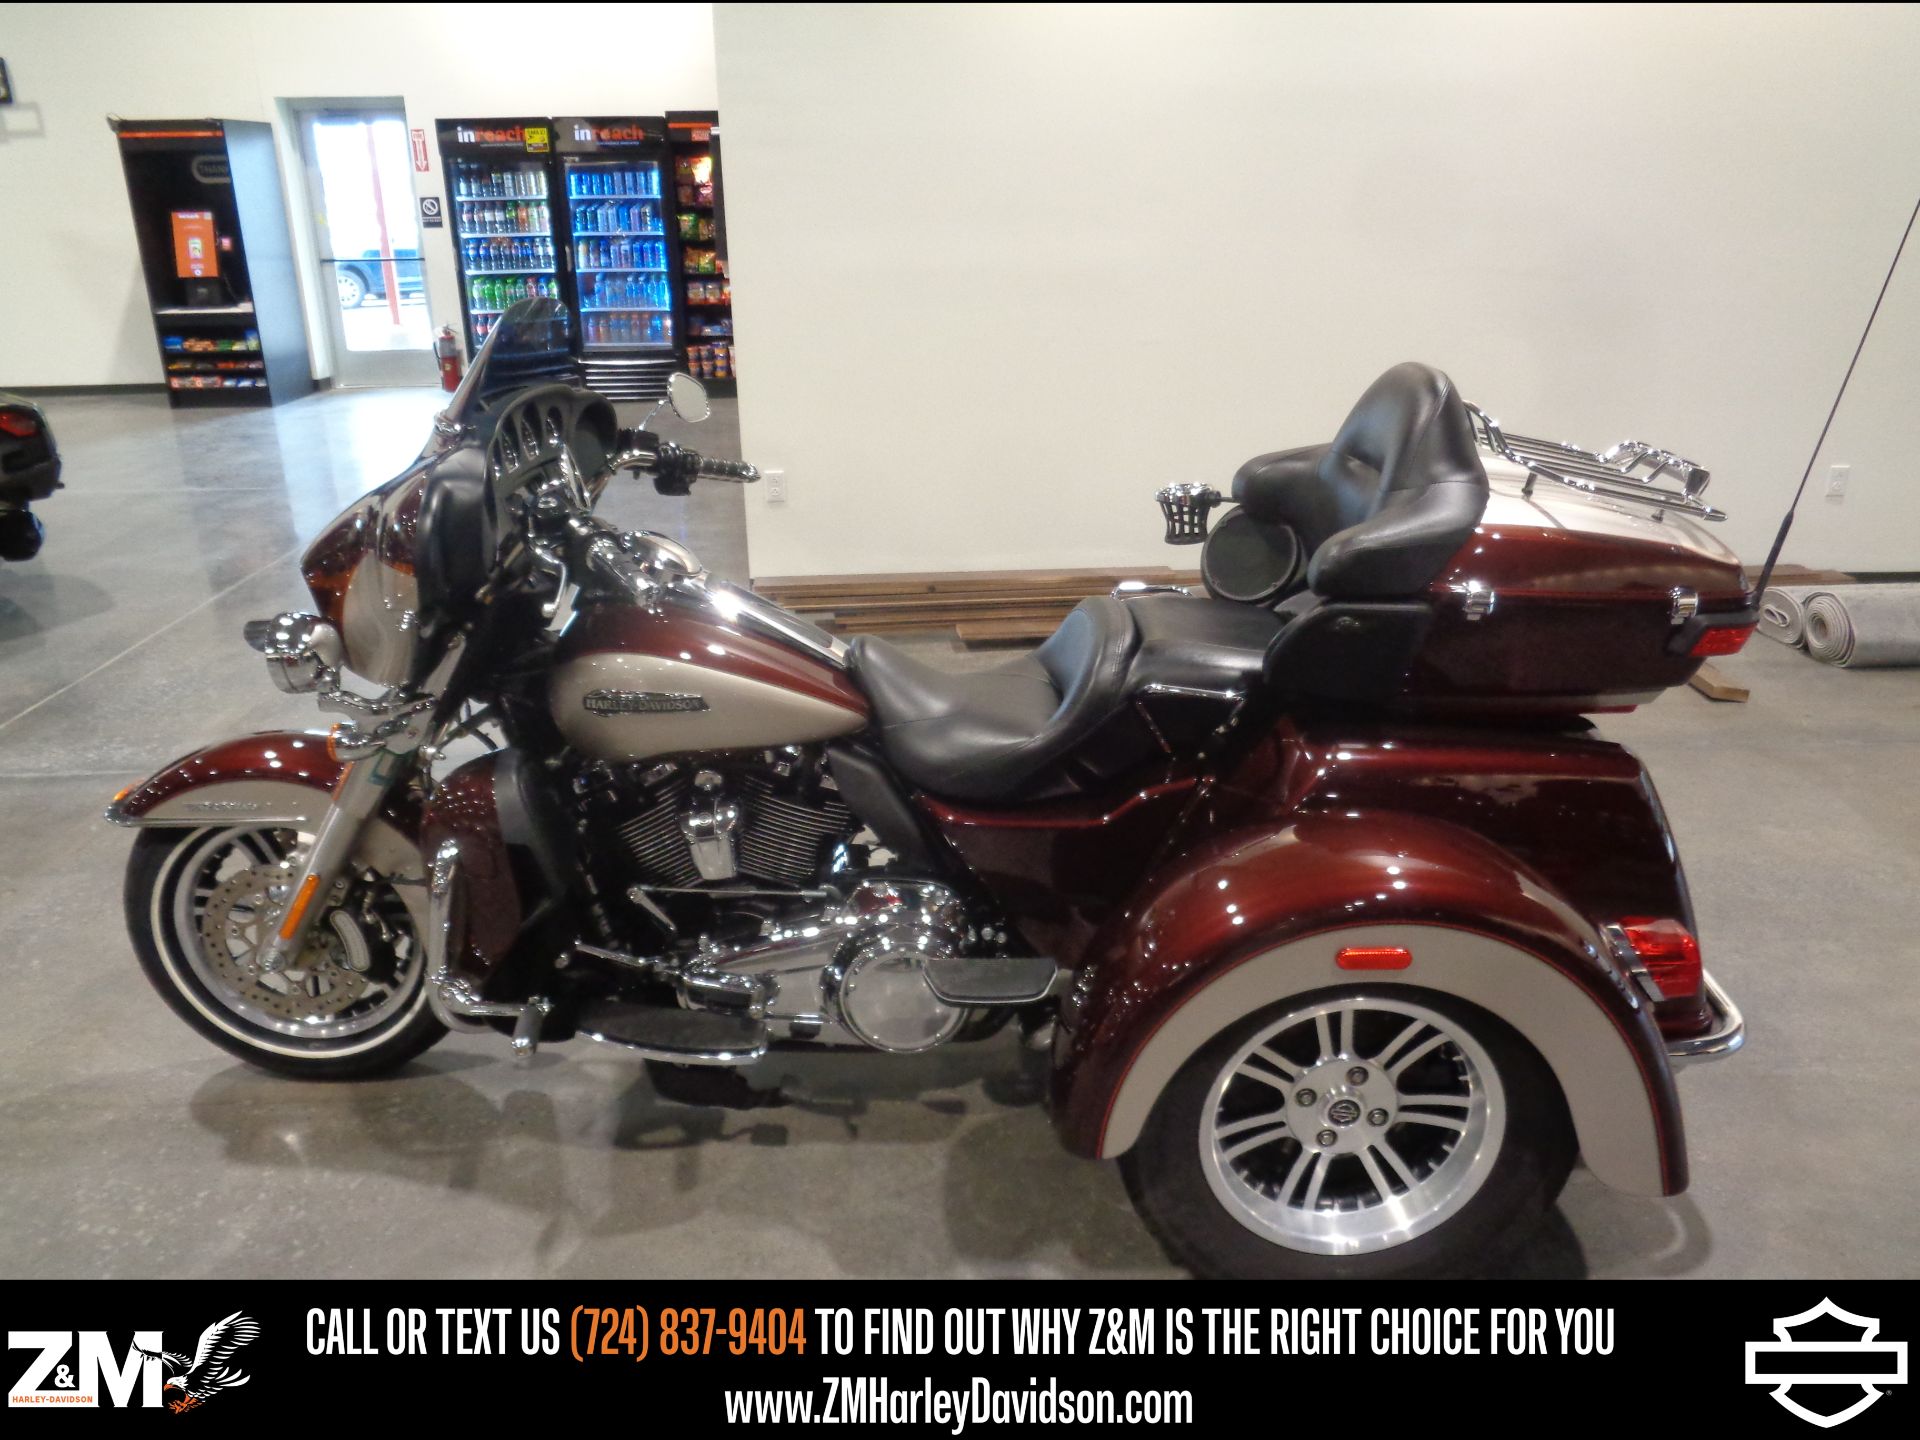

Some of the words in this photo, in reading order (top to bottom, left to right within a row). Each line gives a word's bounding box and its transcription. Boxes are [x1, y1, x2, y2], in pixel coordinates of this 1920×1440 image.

[457, 125, 527, 143] inreach
[574, 124, 645, 142] inreach
[585, 696, 702, 711] HARLEY-DAVIDSON
